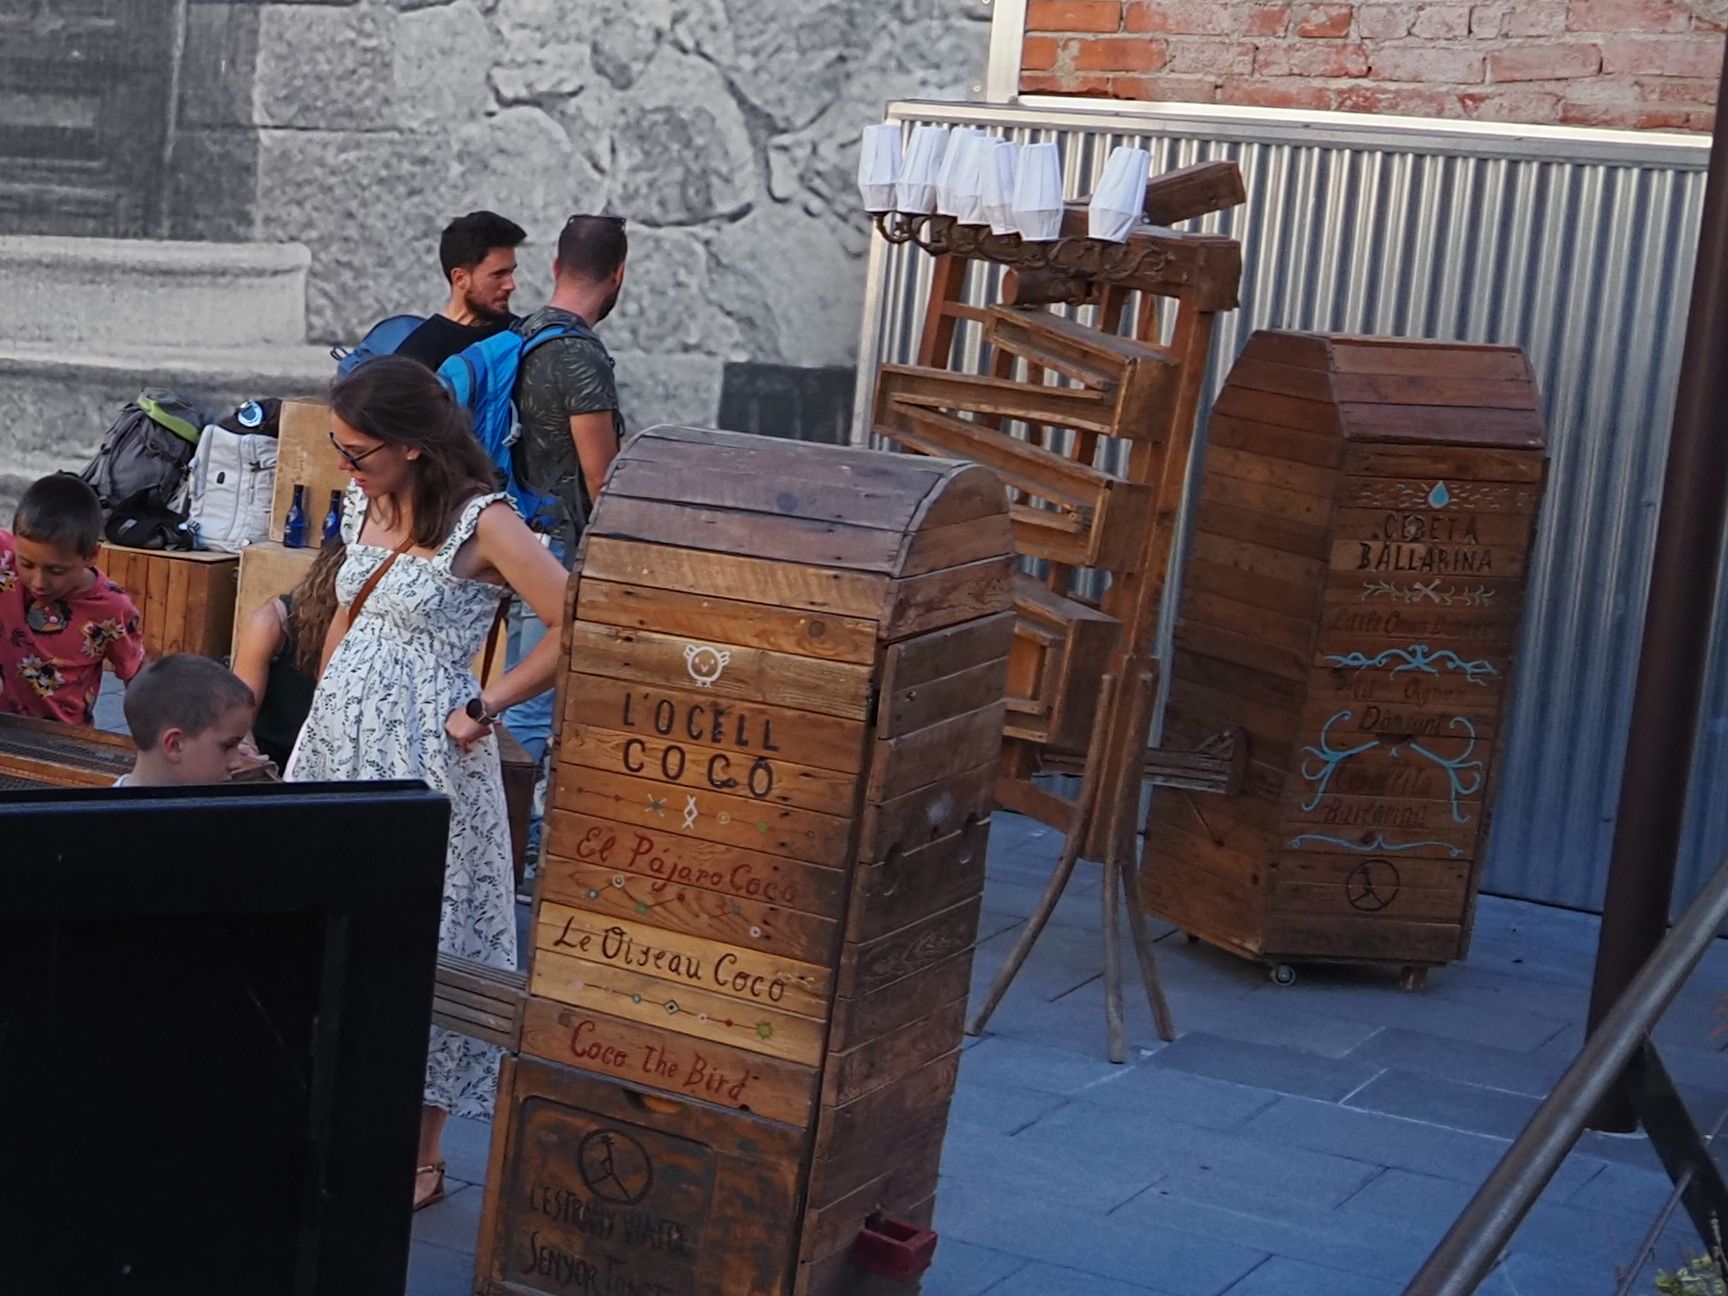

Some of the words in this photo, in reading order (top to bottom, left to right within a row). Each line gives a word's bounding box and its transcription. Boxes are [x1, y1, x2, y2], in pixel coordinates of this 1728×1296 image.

[622, 691, 779, 752] L'OCELL
[623, 737, 776, 799] COCO
[576, 826, 616, 863] El
[628, 831, 724, 893] Pájaro
[729, 864, 796, 902] Coco
[551, 915, 591, 953] Le
[601, 926, 702, 981] Oiseau
[714, 953, 786, 1002] Coco
[570, 1020, 628, 1069] Coco
[642, 1039, 679, 1080] The
[684, 1052, 747, 1102] Bird
